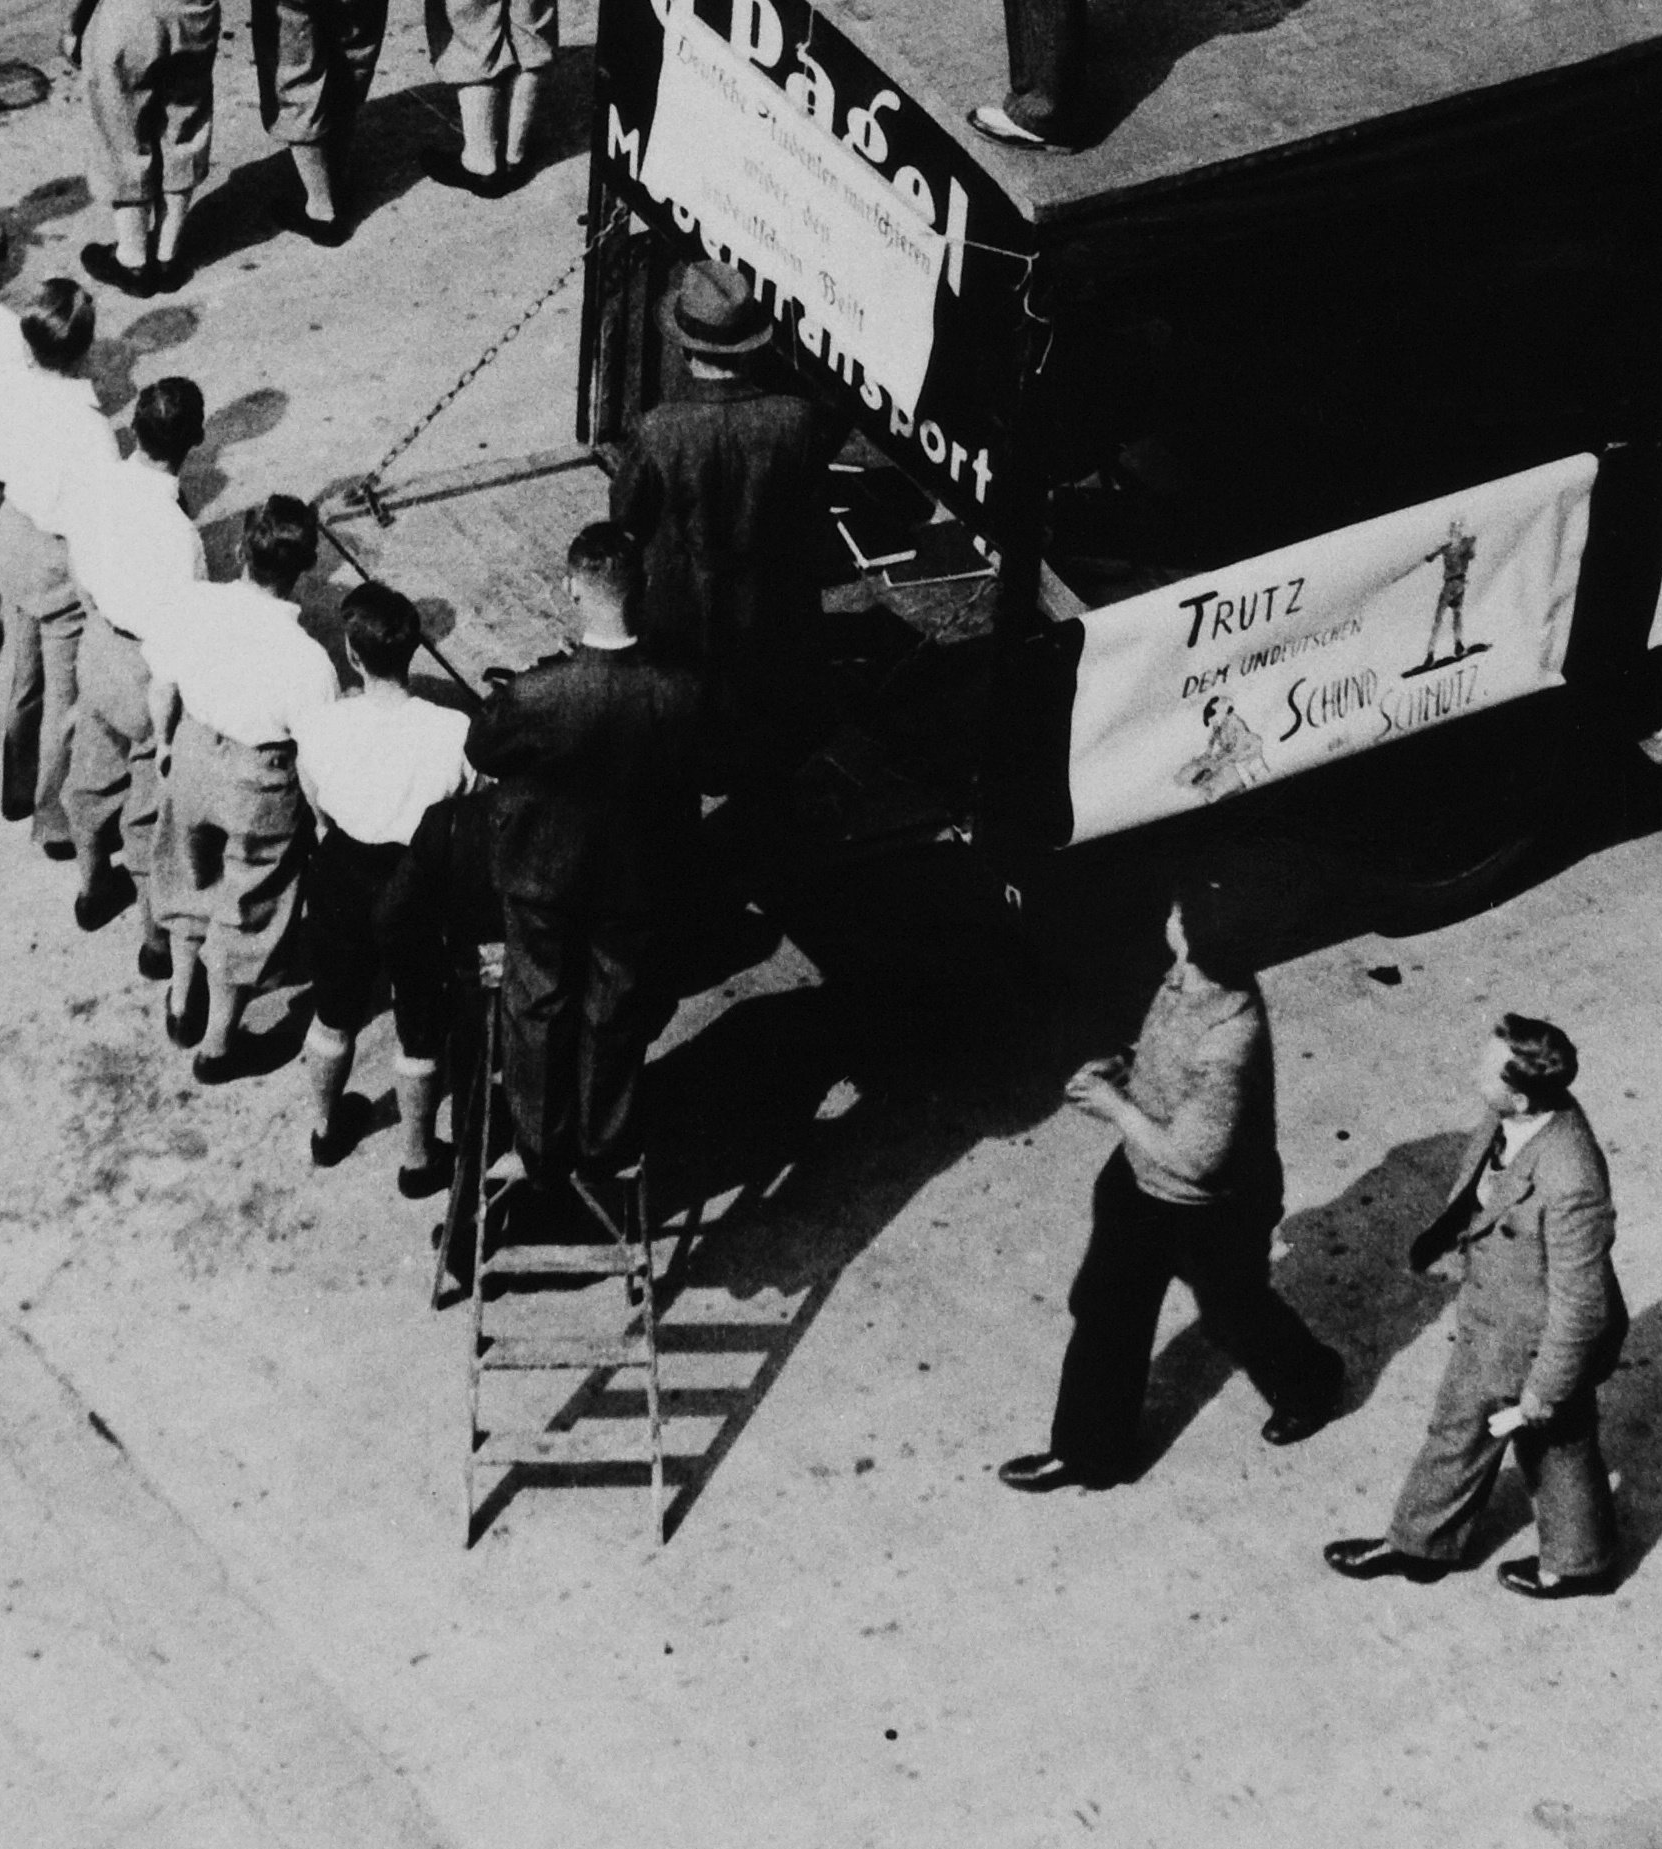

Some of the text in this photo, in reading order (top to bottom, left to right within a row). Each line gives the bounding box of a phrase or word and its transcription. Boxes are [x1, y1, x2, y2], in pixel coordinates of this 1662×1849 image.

[843, 183, 933, 276] marschieren
[1178, 576, 1306, 649] TRUTZ
[1181, 615, 1364, 699] DEM UNDEUTSCHEN
[1279, 667, 1378, 743] SCHUND
